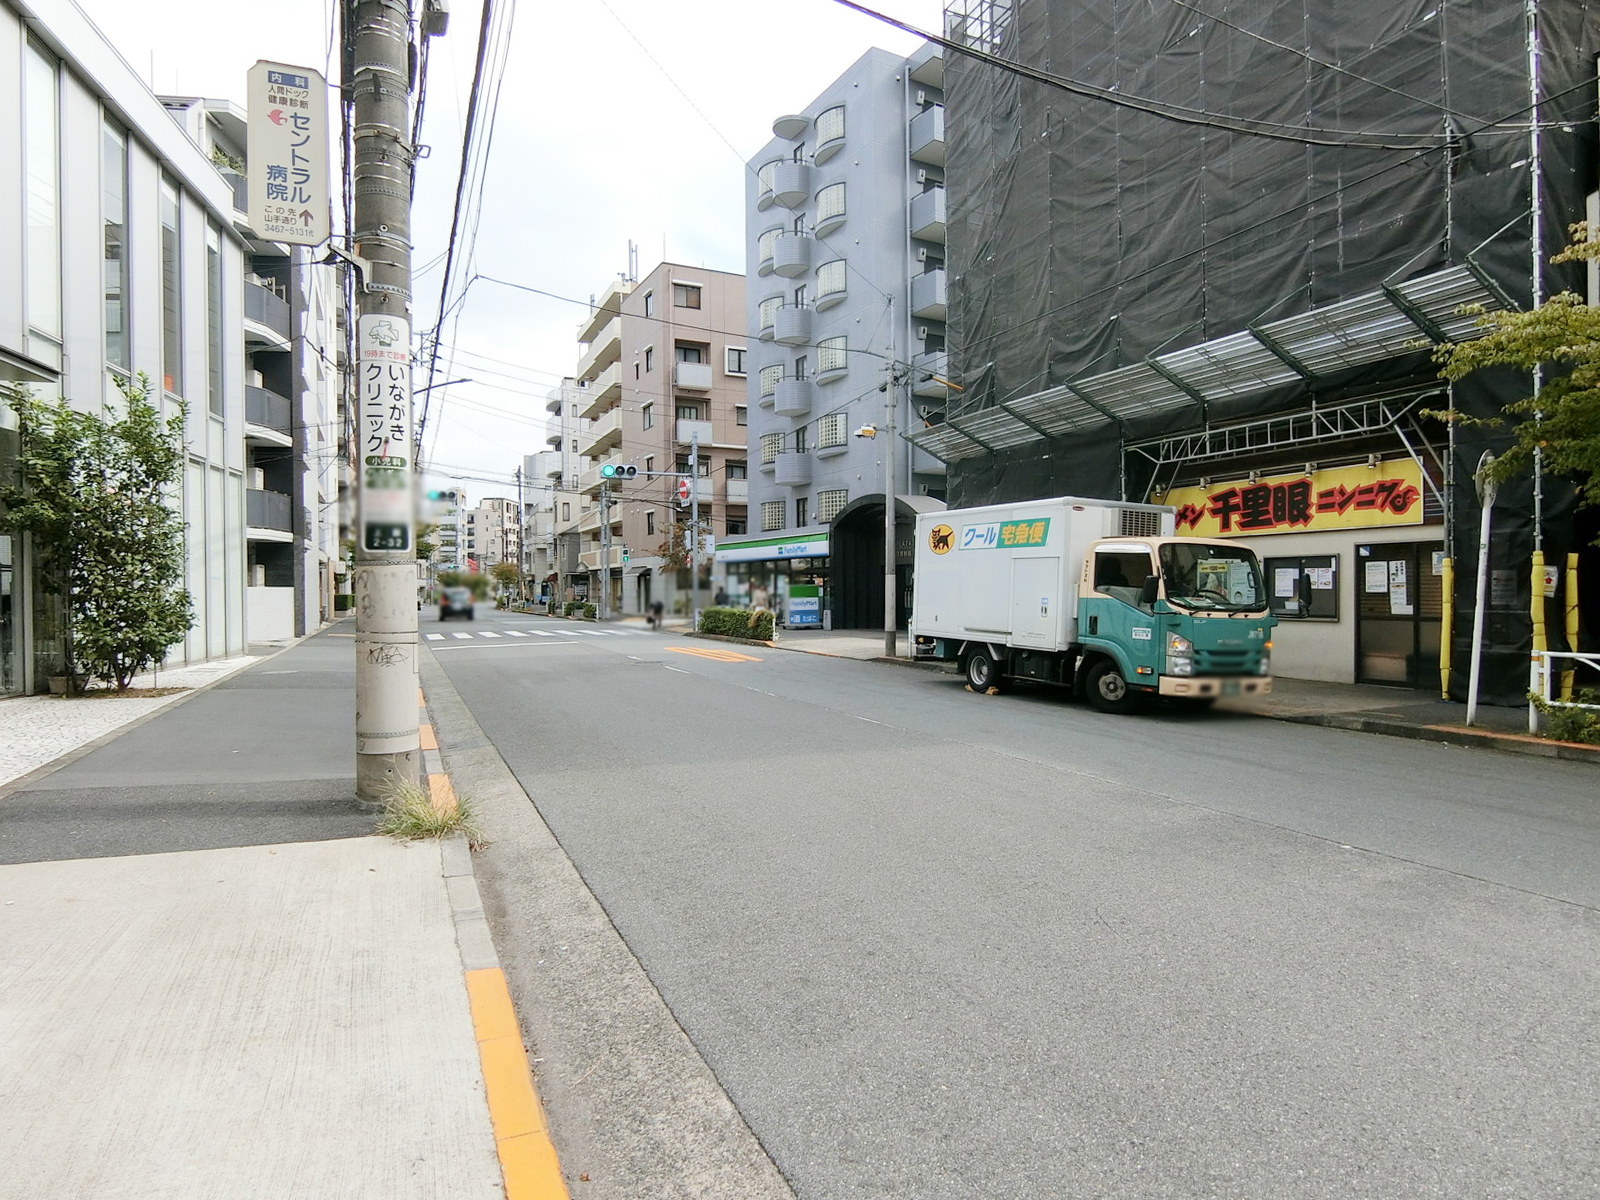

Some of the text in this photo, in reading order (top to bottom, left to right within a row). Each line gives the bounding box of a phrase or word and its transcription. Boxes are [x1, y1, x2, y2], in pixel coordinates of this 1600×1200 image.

[268, 84, 309, 99] 人間ドック
[271, 72, 306, 88] 内科
[268, 94, 309, 110] 健康診断
[290, 112, 311, 205] セントラル
[267, 164, 288, 202] 病院
[264, 205, 297, 217] この先
[264, 214, 298, 226] 山手通り
[366, 363, 384, 452] クリニック
[388, 364, 406, 441] いながき
[1207, 478, 1314, 533] 千里眼
